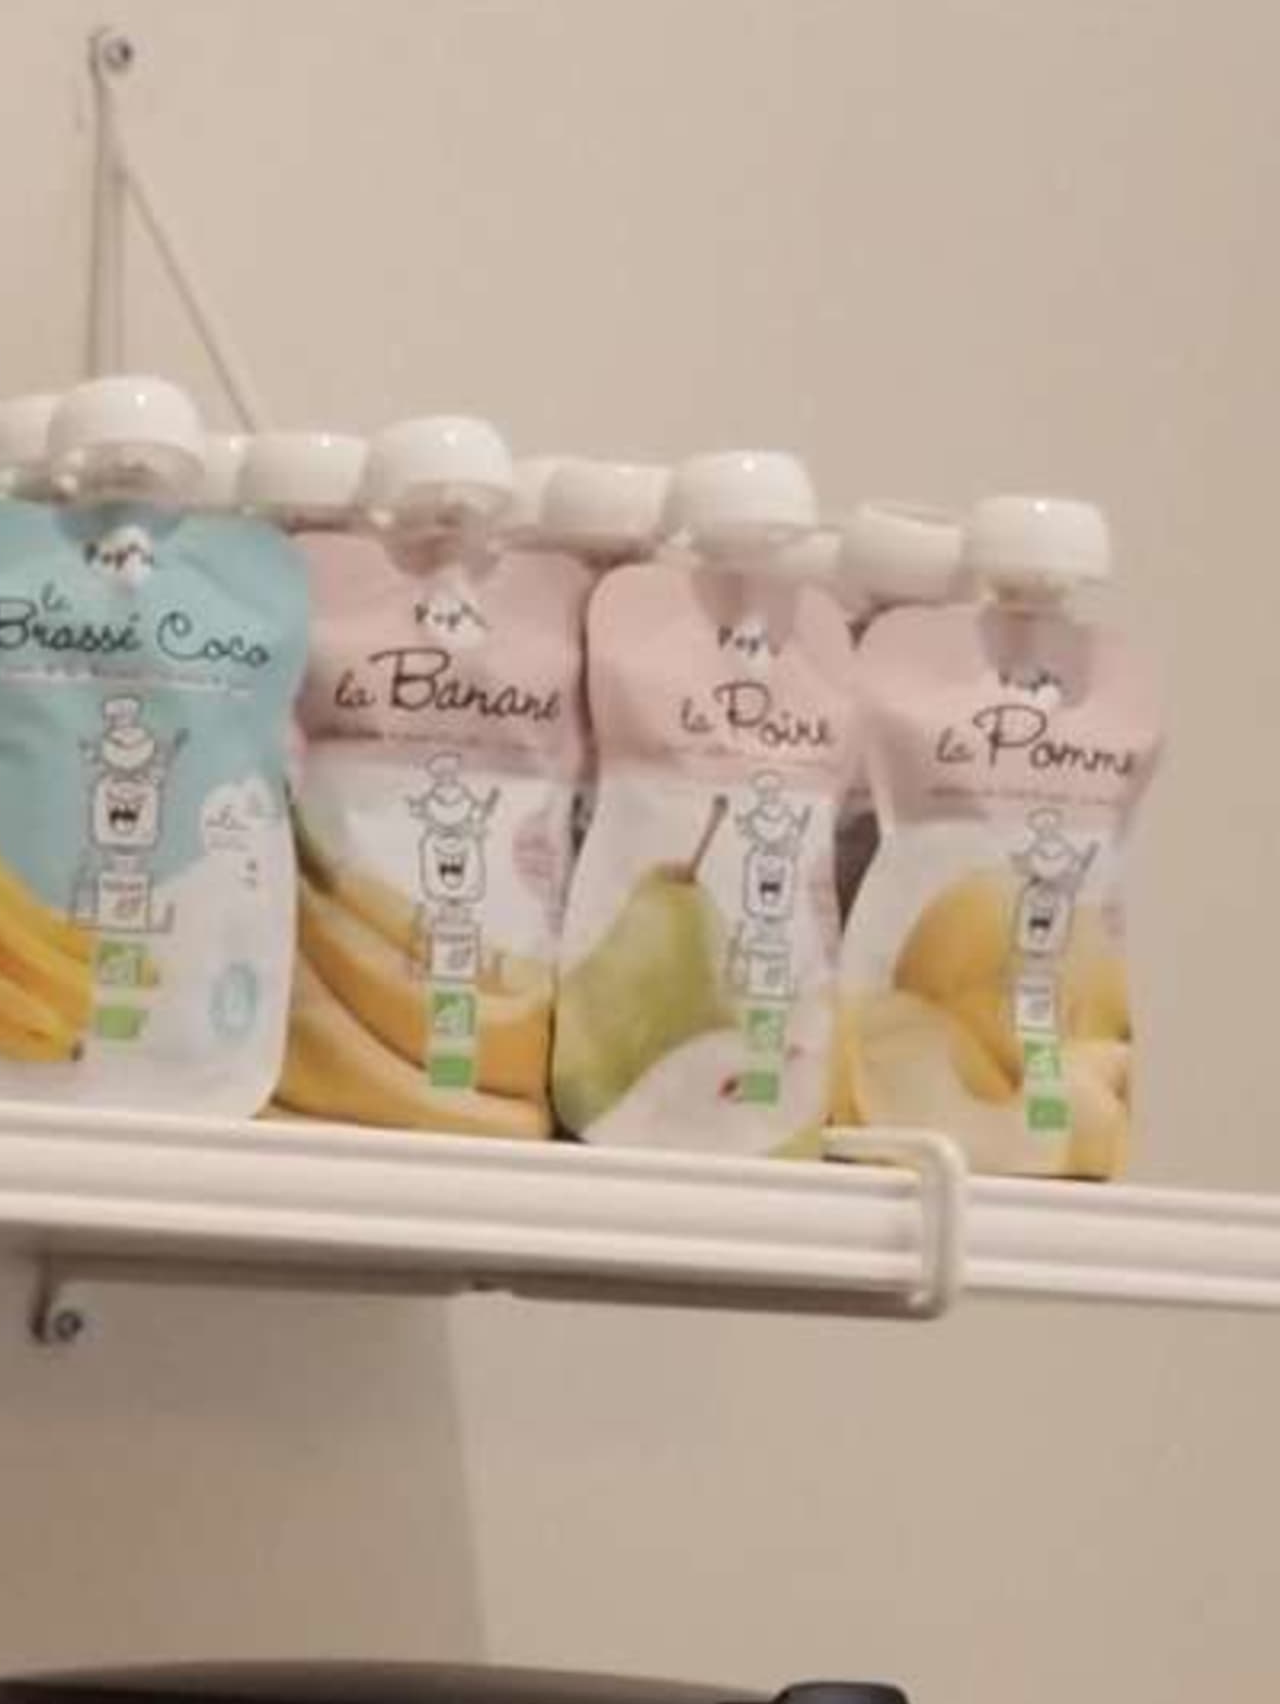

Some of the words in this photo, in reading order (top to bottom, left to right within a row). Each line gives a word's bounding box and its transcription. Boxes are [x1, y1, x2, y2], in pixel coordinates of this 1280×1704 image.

[157, 611, 270, 667] Coco
[334, 669, 374, 708] la
[369, 647, 560, 720] Banane
[712, 681, 834, 746] Poire
[973, 705, 1133, 773] Pomme
